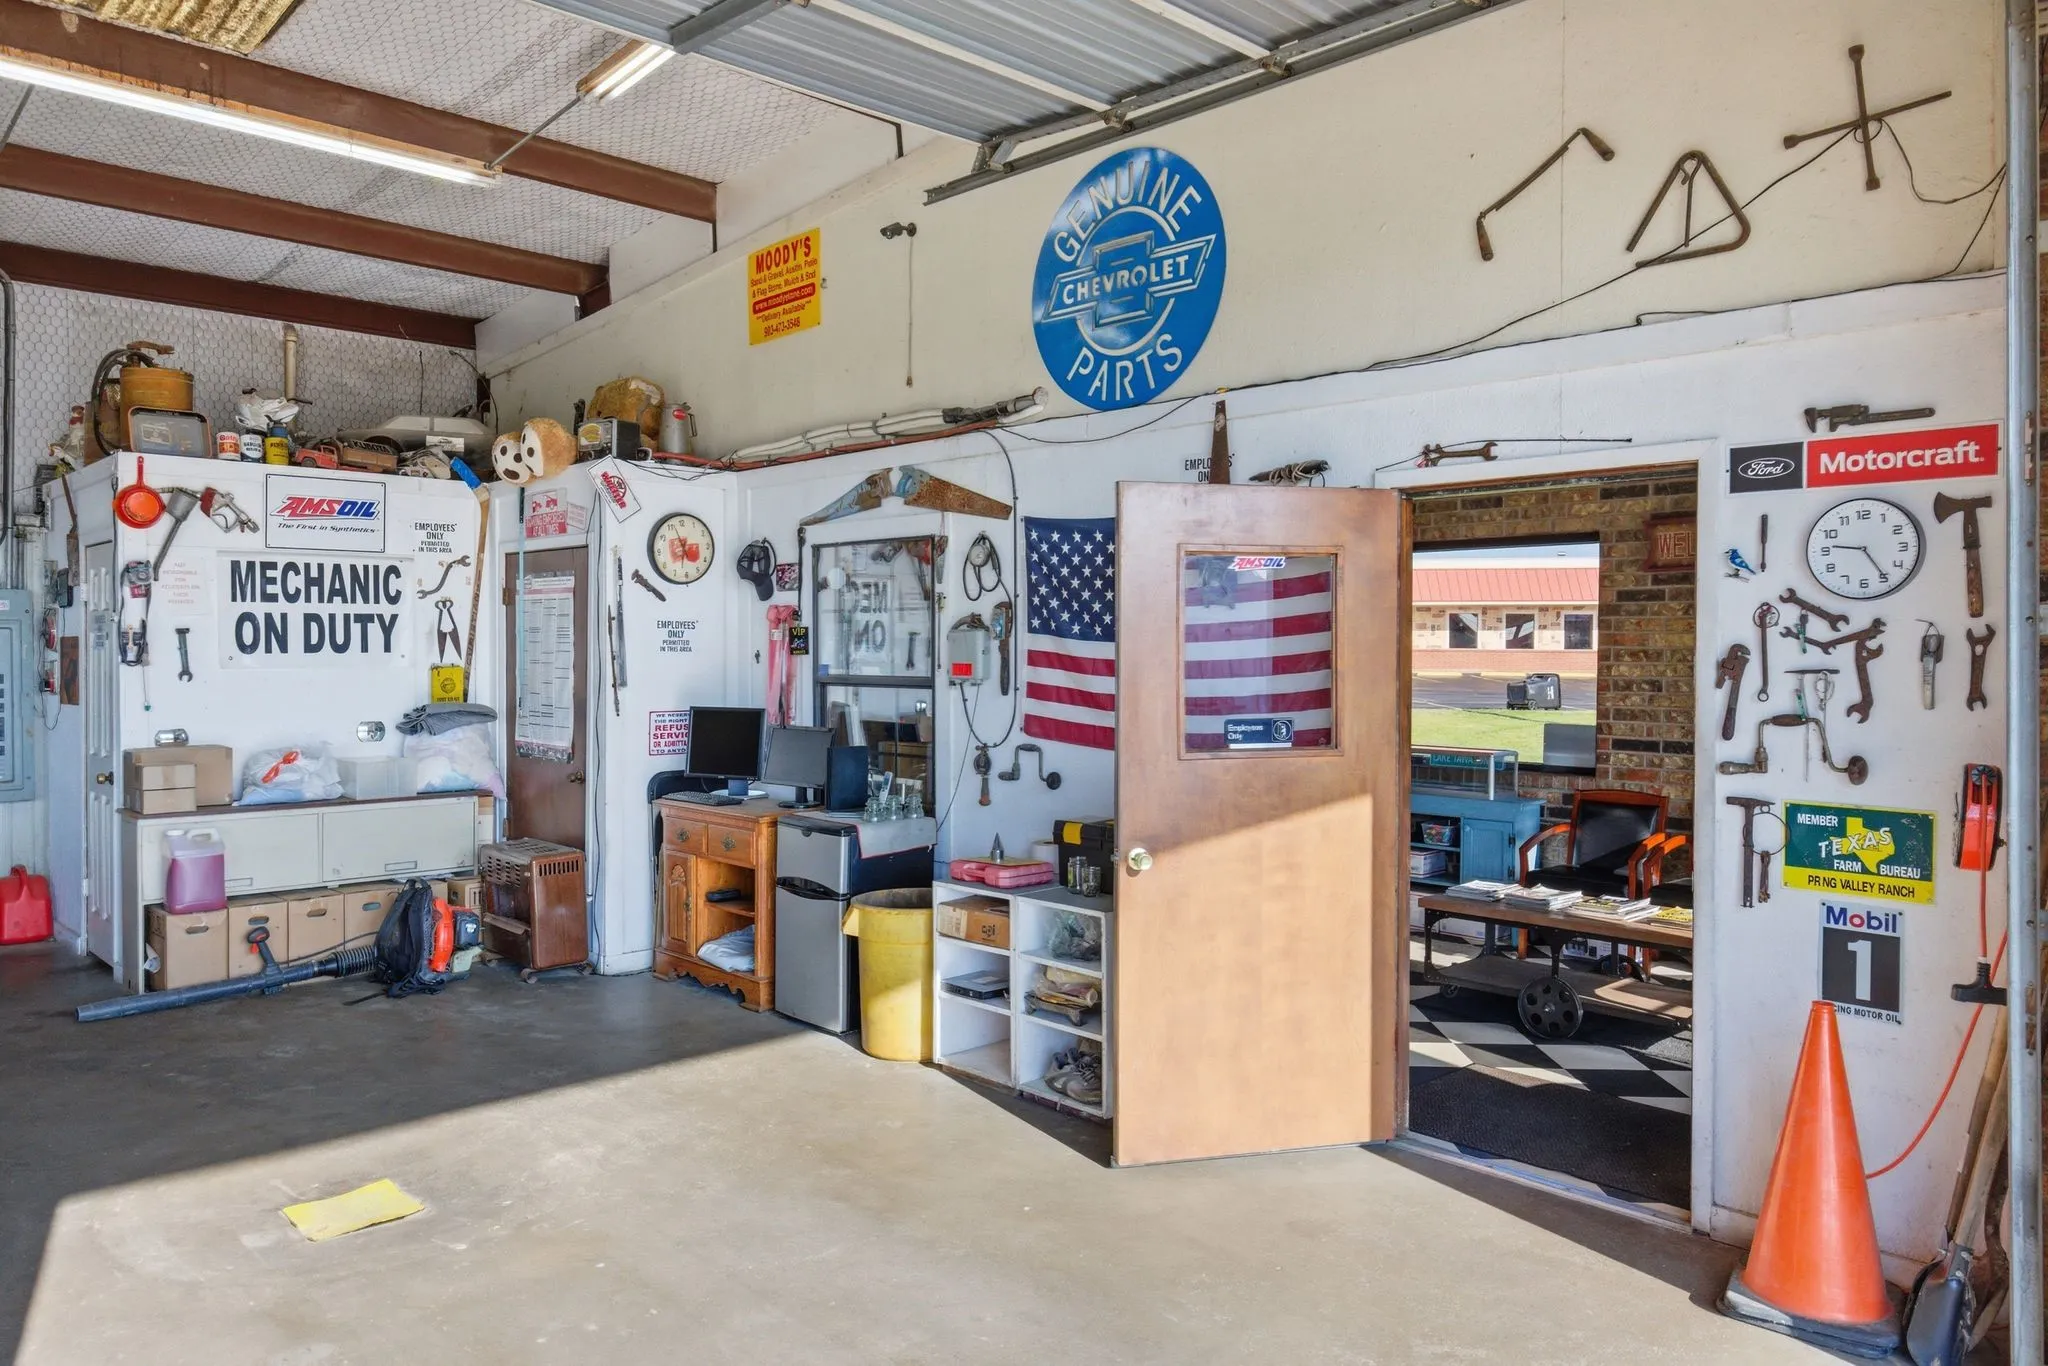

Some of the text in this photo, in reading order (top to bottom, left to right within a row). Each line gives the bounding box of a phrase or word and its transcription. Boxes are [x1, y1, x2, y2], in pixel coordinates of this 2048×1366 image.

[1053, 160, 1203, 263] GENUINE
[755, 236, 811, 274] MOODY'S
[1062, 254, 1191, 306] CHEVROLET
[1066, 333, 1184, 402] PARTS
[1746, 439, 1981, 476] Ford Motorcraft
[276, 496, 377, 519] AMSOIL
[1855, 509, 1871, 520] 12
[1880, 513, 1886, 523] 1
[1838, 516, 1850, 526] 11
[1823, 529, 1838, 539] 10
[1892, 524, 1903, 535] 2
[426, 532, 444, 540] ONLY
[1821, 546, 1830, 556] 9
[1897, 542, 1908, 552] 3
[1234, 557, 1284, 570] AMSOIL
[1826, 563, 1836, 573] 8
[1893, 560, 1903, 569] 4
[230, 560, 402, 605] MECHANIC
[1840, 575, 1850, 584] 7
[1860, 579, 1869, 588] 6
[235, 611, 399, 655] ON DUTY
[668, 630, 685, 638] ONLY
[792, 628, 806, 636] VIP
[1227, 724, 1263, 732] Employees
[653, 732, 689, 740] SERVIC
[1227, 732, 1242, 740] Only
[1797, 813, 1838, 827] MEMBER
[1818, 827, 1890, 858] TEXAS
[1833, 859, 1920, 879] FARM BUREAU
[1840, 878, 1875, 893] VALLEY
[1878, 883, 1915, 898] RANCH
[1826, 905, 1897, 933] Mobil
[1847, 939, 1872, 1001] 1
[1854, 1007, 1883, 1020] MOTOR
[1886, 1013, 1900, 1024] OIL
